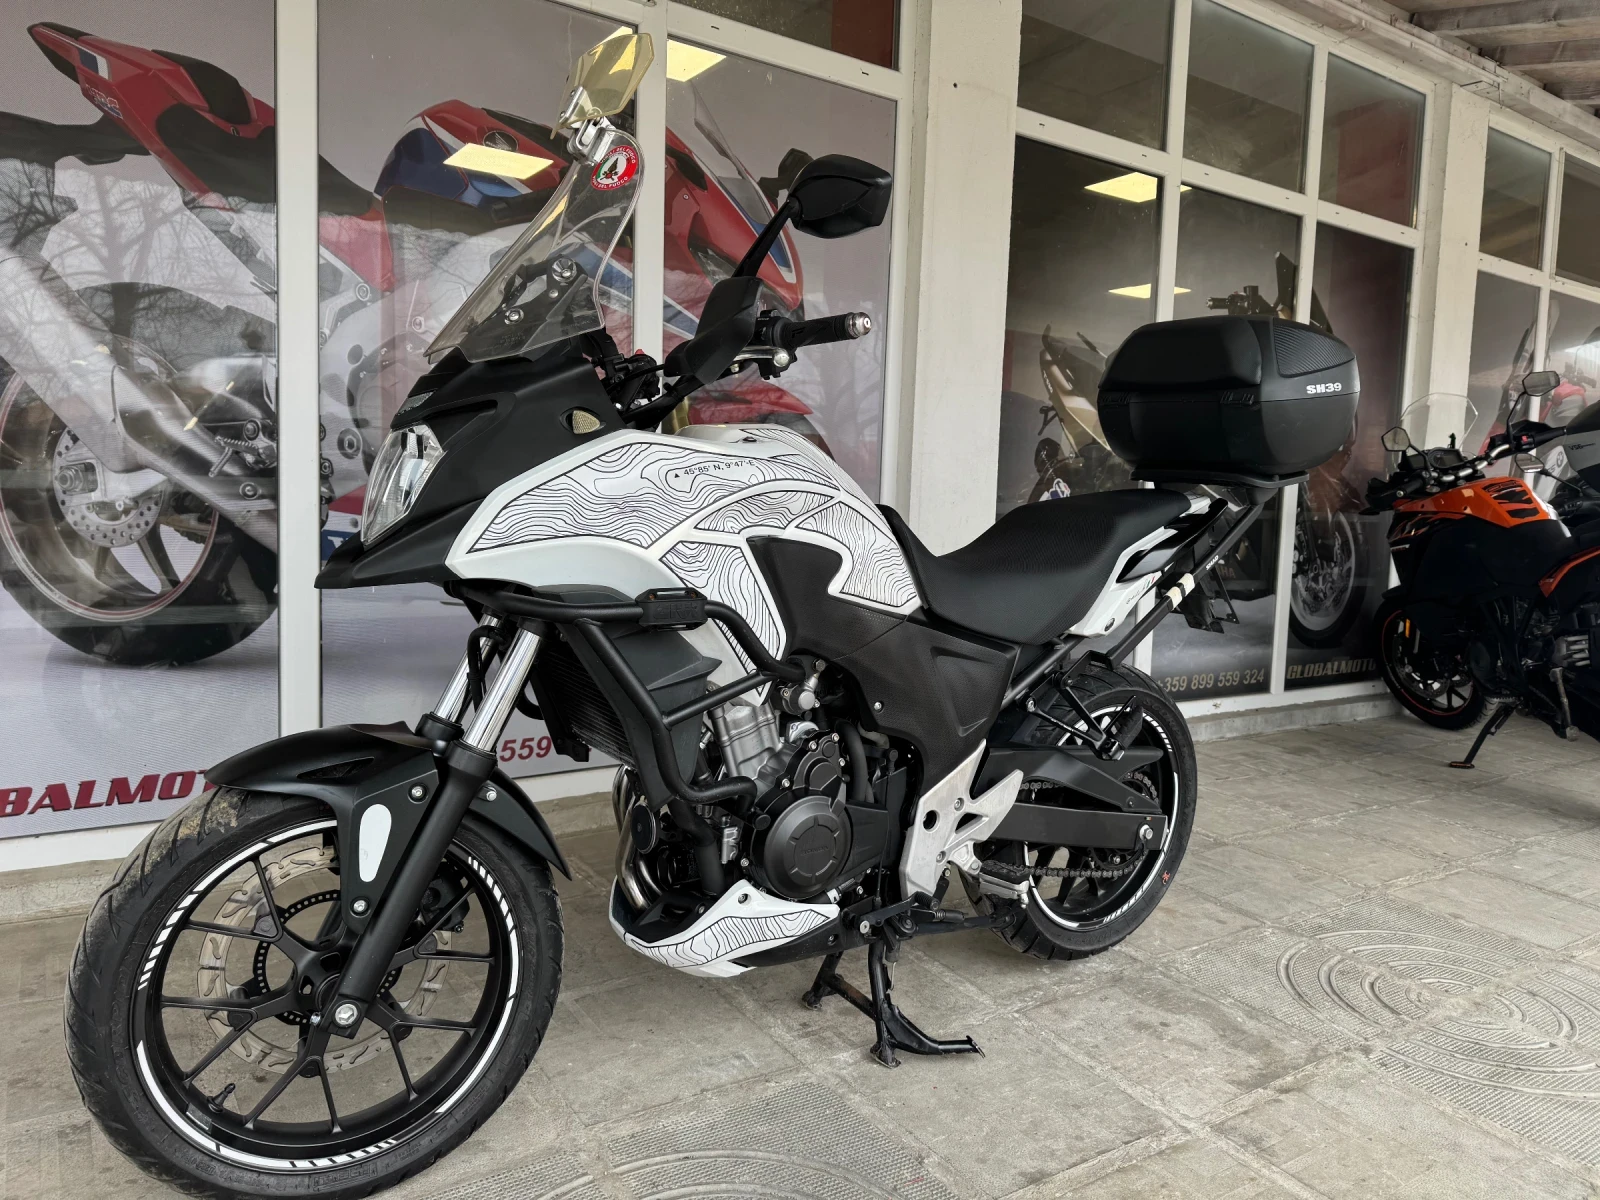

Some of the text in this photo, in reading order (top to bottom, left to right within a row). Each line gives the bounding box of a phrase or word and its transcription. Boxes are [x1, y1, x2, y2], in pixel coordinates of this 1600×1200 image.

[608, 176, 629, 188] FUOCO
[1306, 382, 1342, 394] SH39
[1191, 673, 1213, 690] 899
[1217, 670, 1240, 688] 559
[1243, 668, 1265, 685] 324
[499, 735, 553, 762] 559
